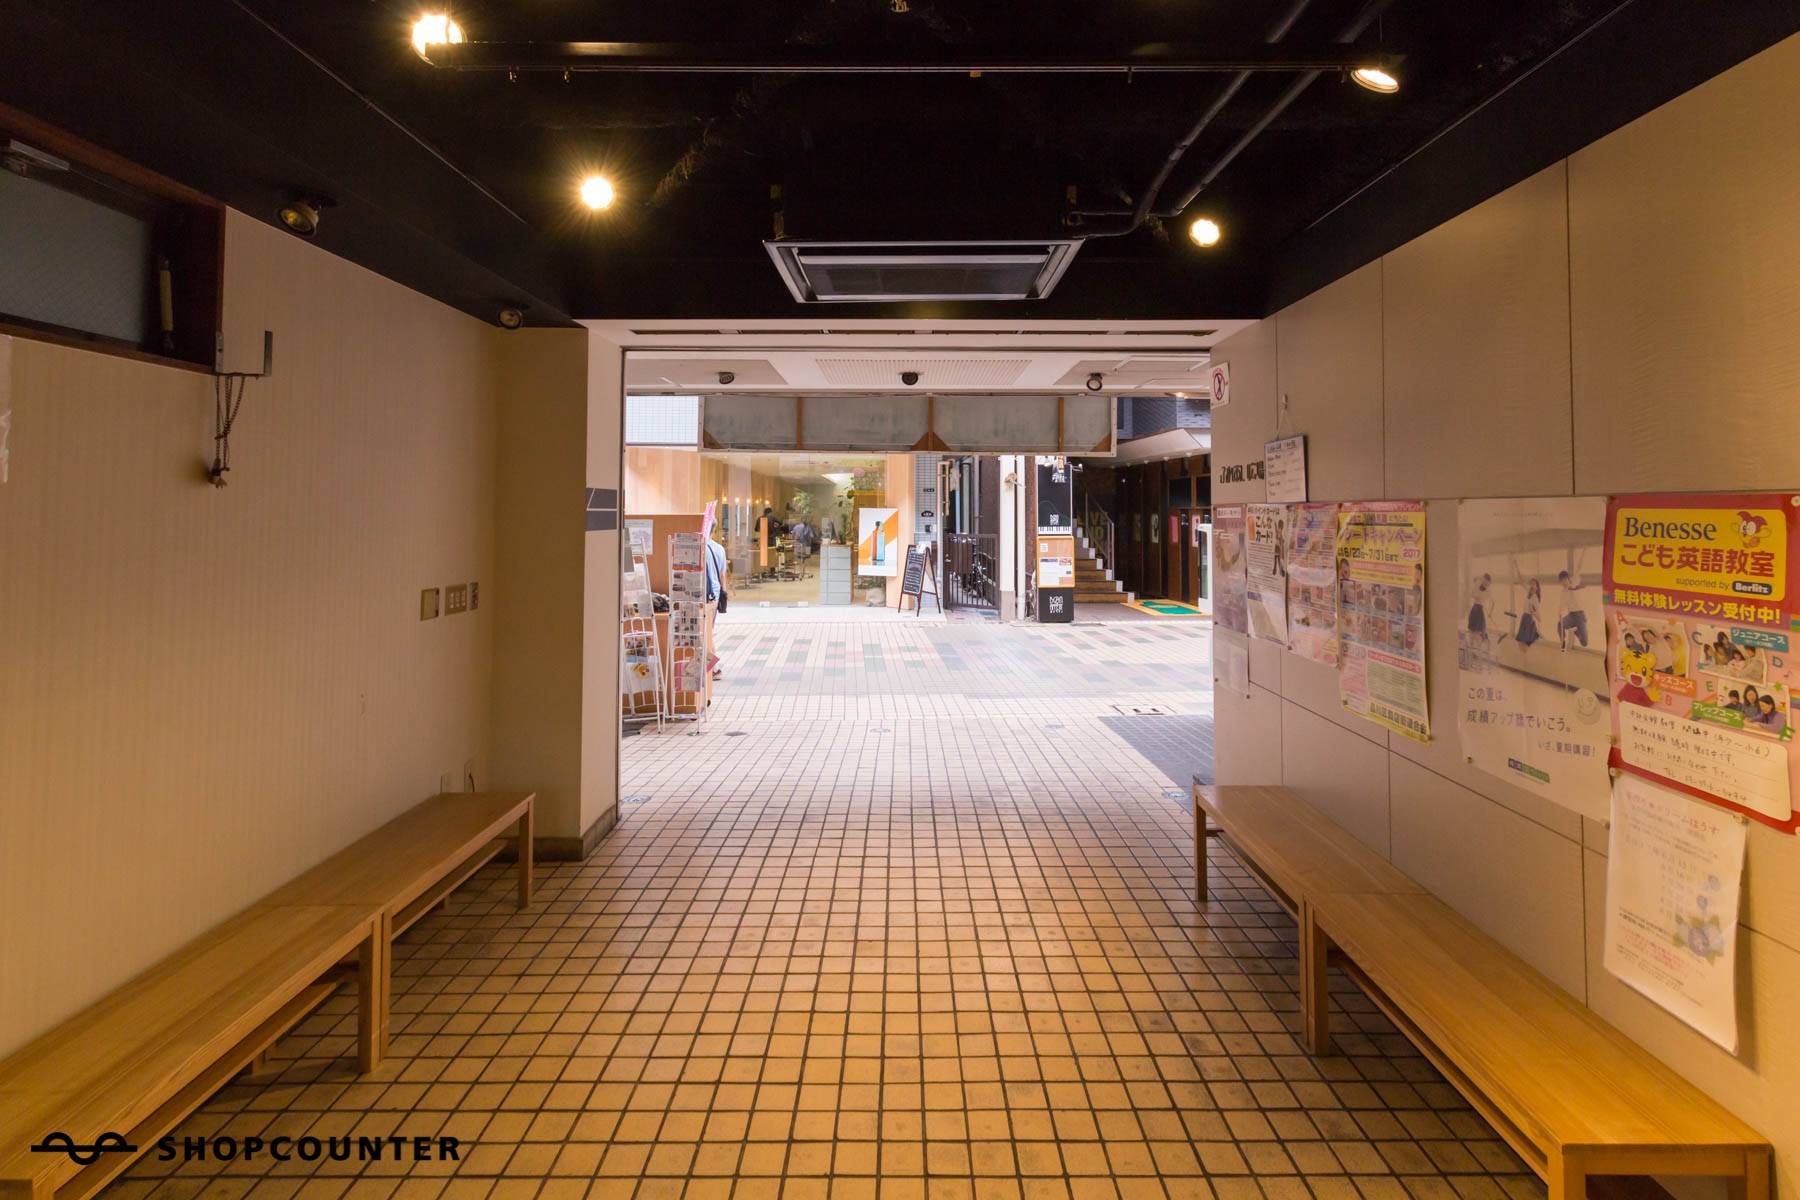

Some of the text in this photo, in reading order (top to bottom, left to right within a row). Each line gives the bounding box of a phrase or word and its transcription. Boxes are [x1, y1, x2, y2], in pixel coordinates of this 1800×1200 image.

[1624, 516, 1717, 541] Benesse
[1402, 547, 1422, 560] 2017
[1621, 543, 1776, 578] こども英語教室
[1675, 577, 1770, 594] supported by Berlitz
[1613, 589, 1781, 625] 無料体験レッスン受付中!
[1732, 628, 1785, 645] ジュニアコース
[1693, 702, 1741, 721] プレップコース
